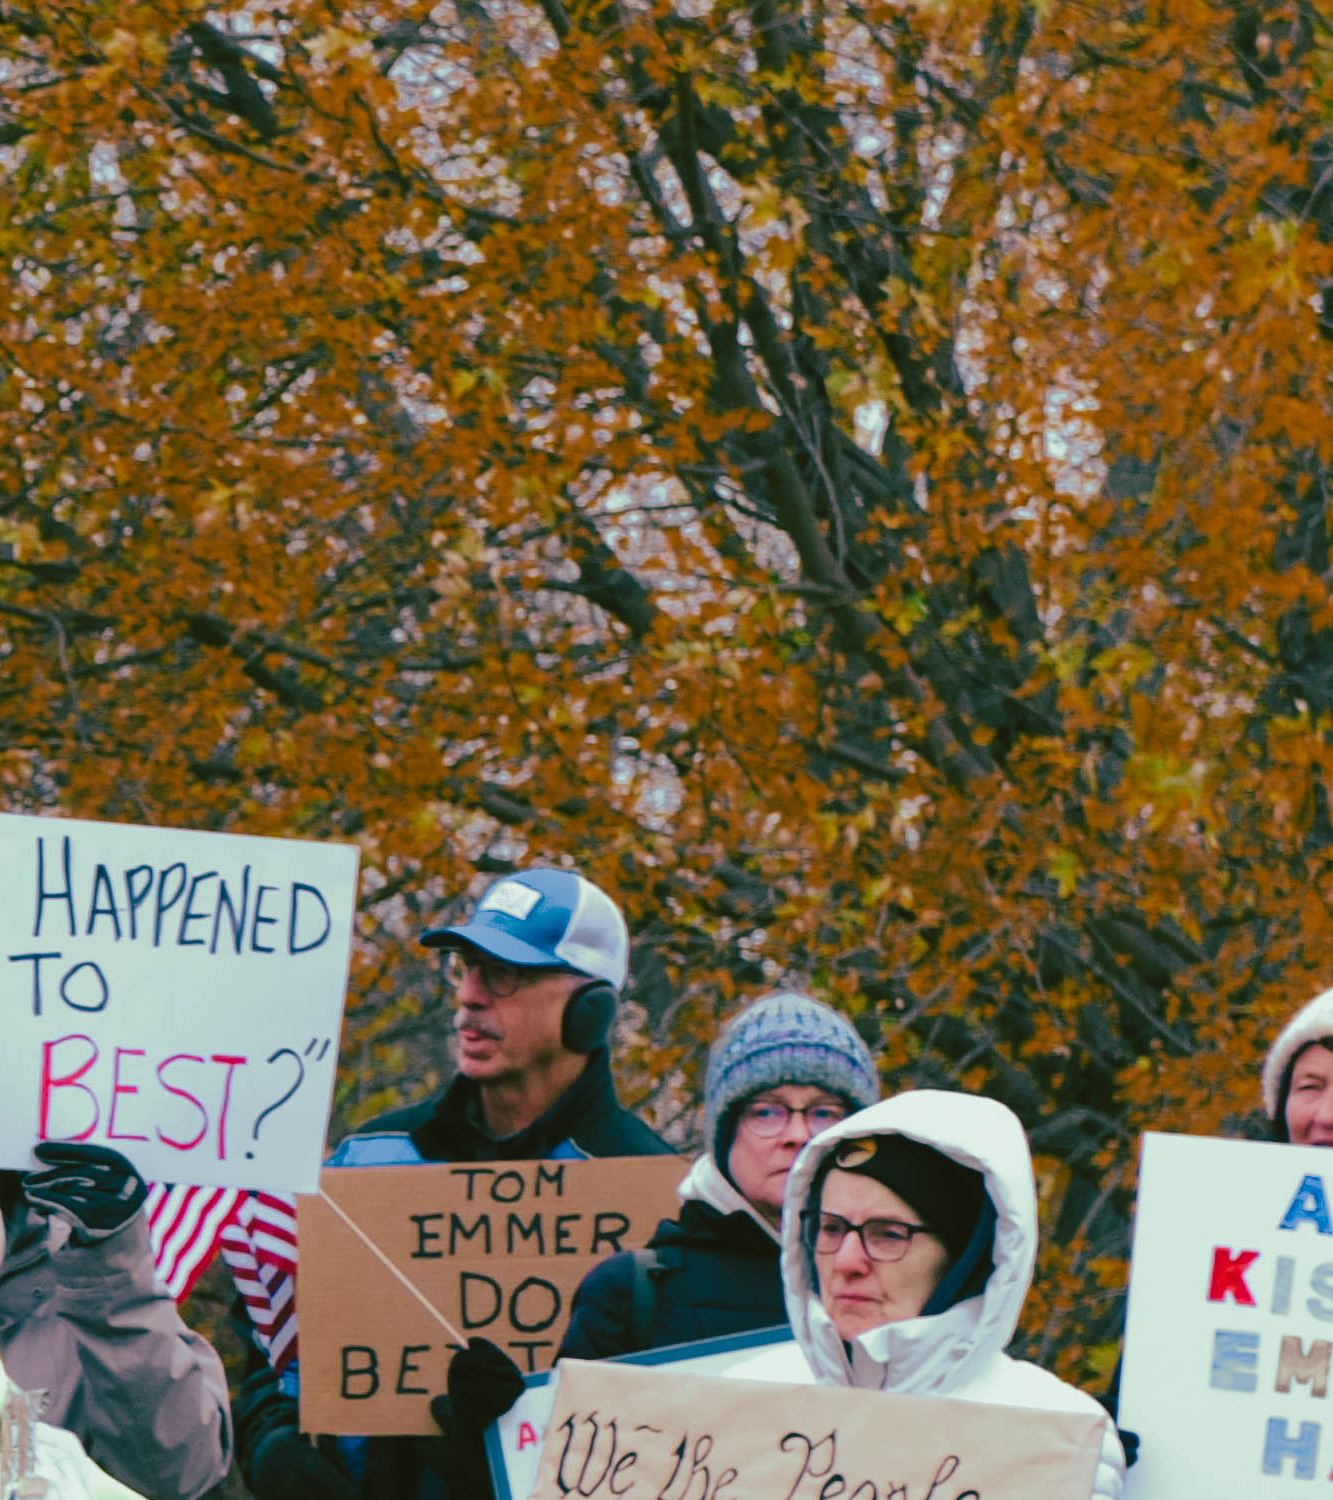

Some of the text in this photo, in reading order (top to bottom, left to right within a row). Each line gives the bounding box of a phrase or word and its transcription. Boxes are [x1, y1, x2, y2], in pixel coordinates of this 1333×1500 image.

[32, 835, 332, 956] HAPPENED
[8, 951, 109, 1016] TO
[450, 1165, 566, 1203] TOM
[410, 1212, 631, 1259] EMMER
[459, 1271, 562, 1334] DO
[556, 1410, 639, 1500] We
